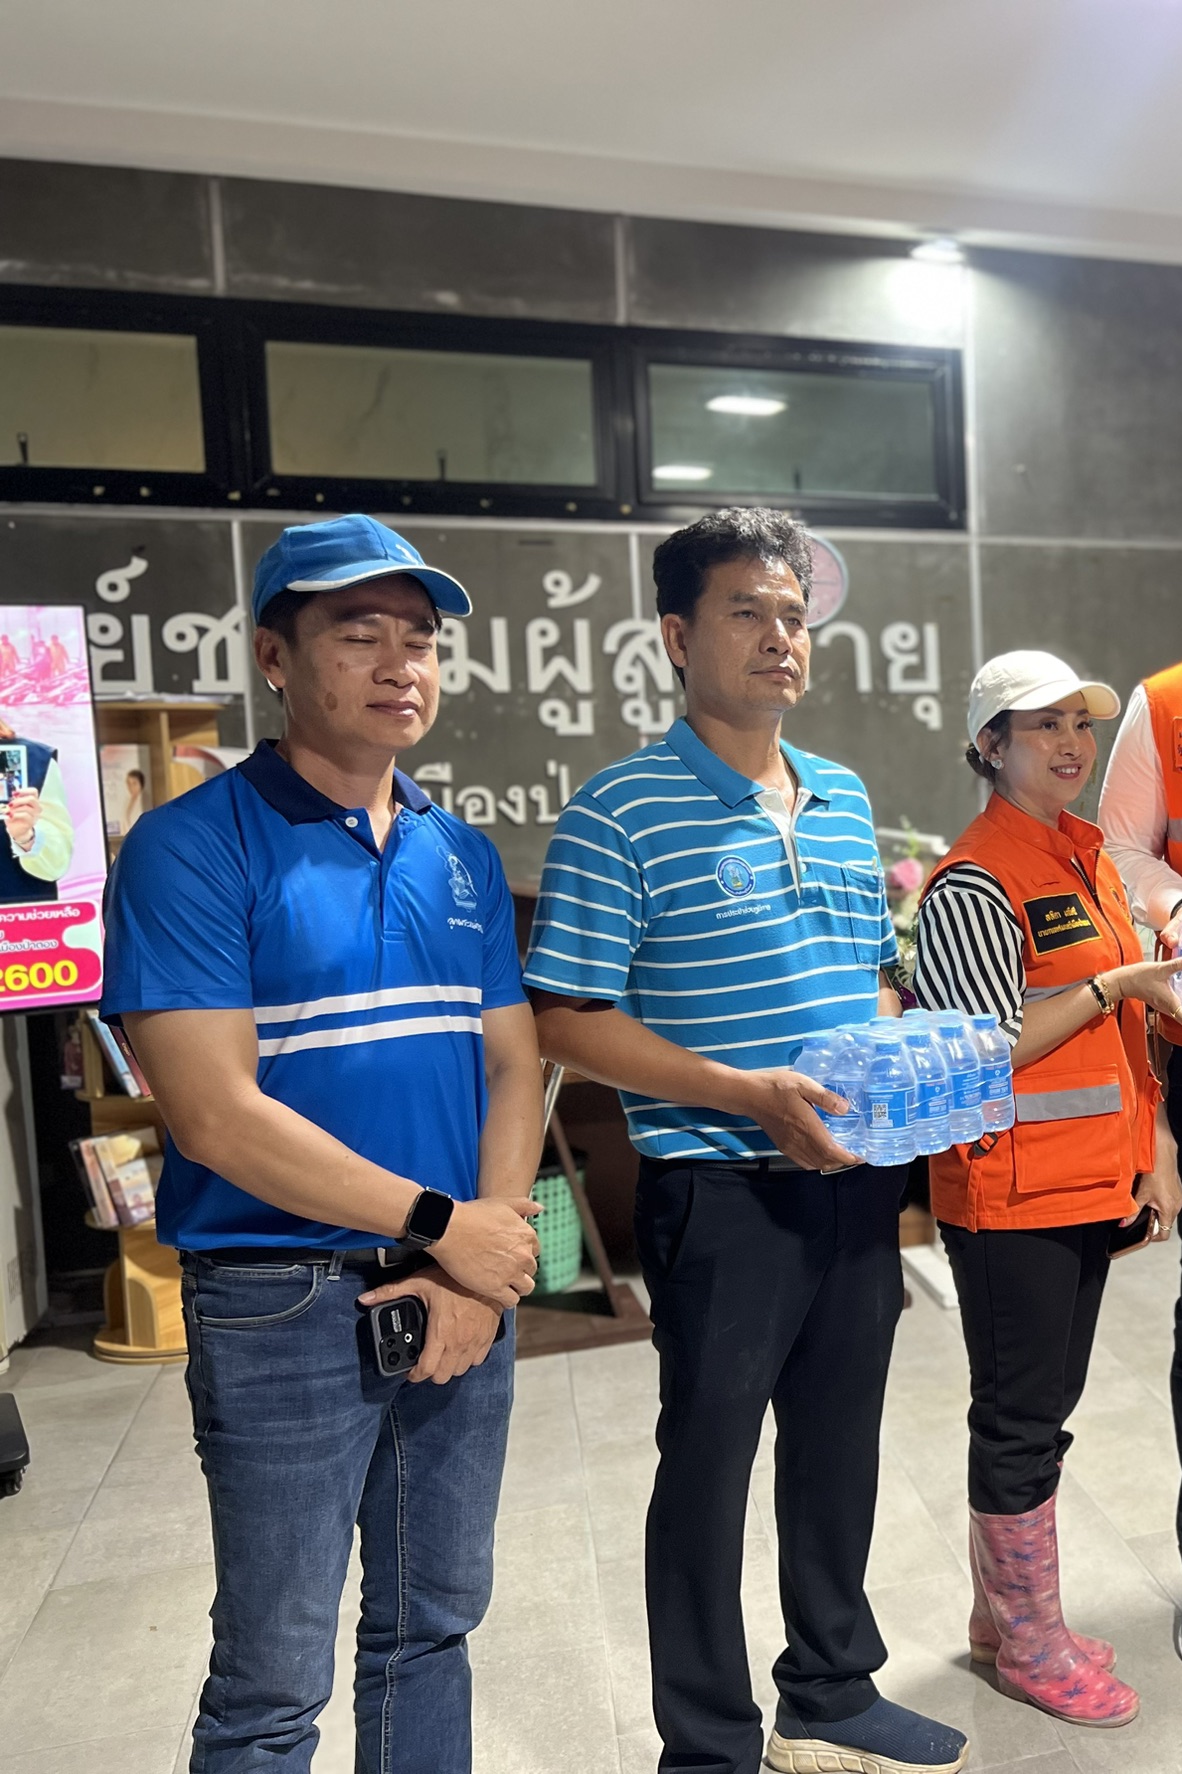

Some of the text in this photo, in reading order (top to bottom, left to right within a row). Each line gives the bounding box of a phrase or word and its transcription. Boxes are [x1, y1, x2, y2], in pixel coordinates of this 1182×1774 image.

[0, 939, 58, 952] มืองป่าตอง
[0, 960, 78, 992] 600
